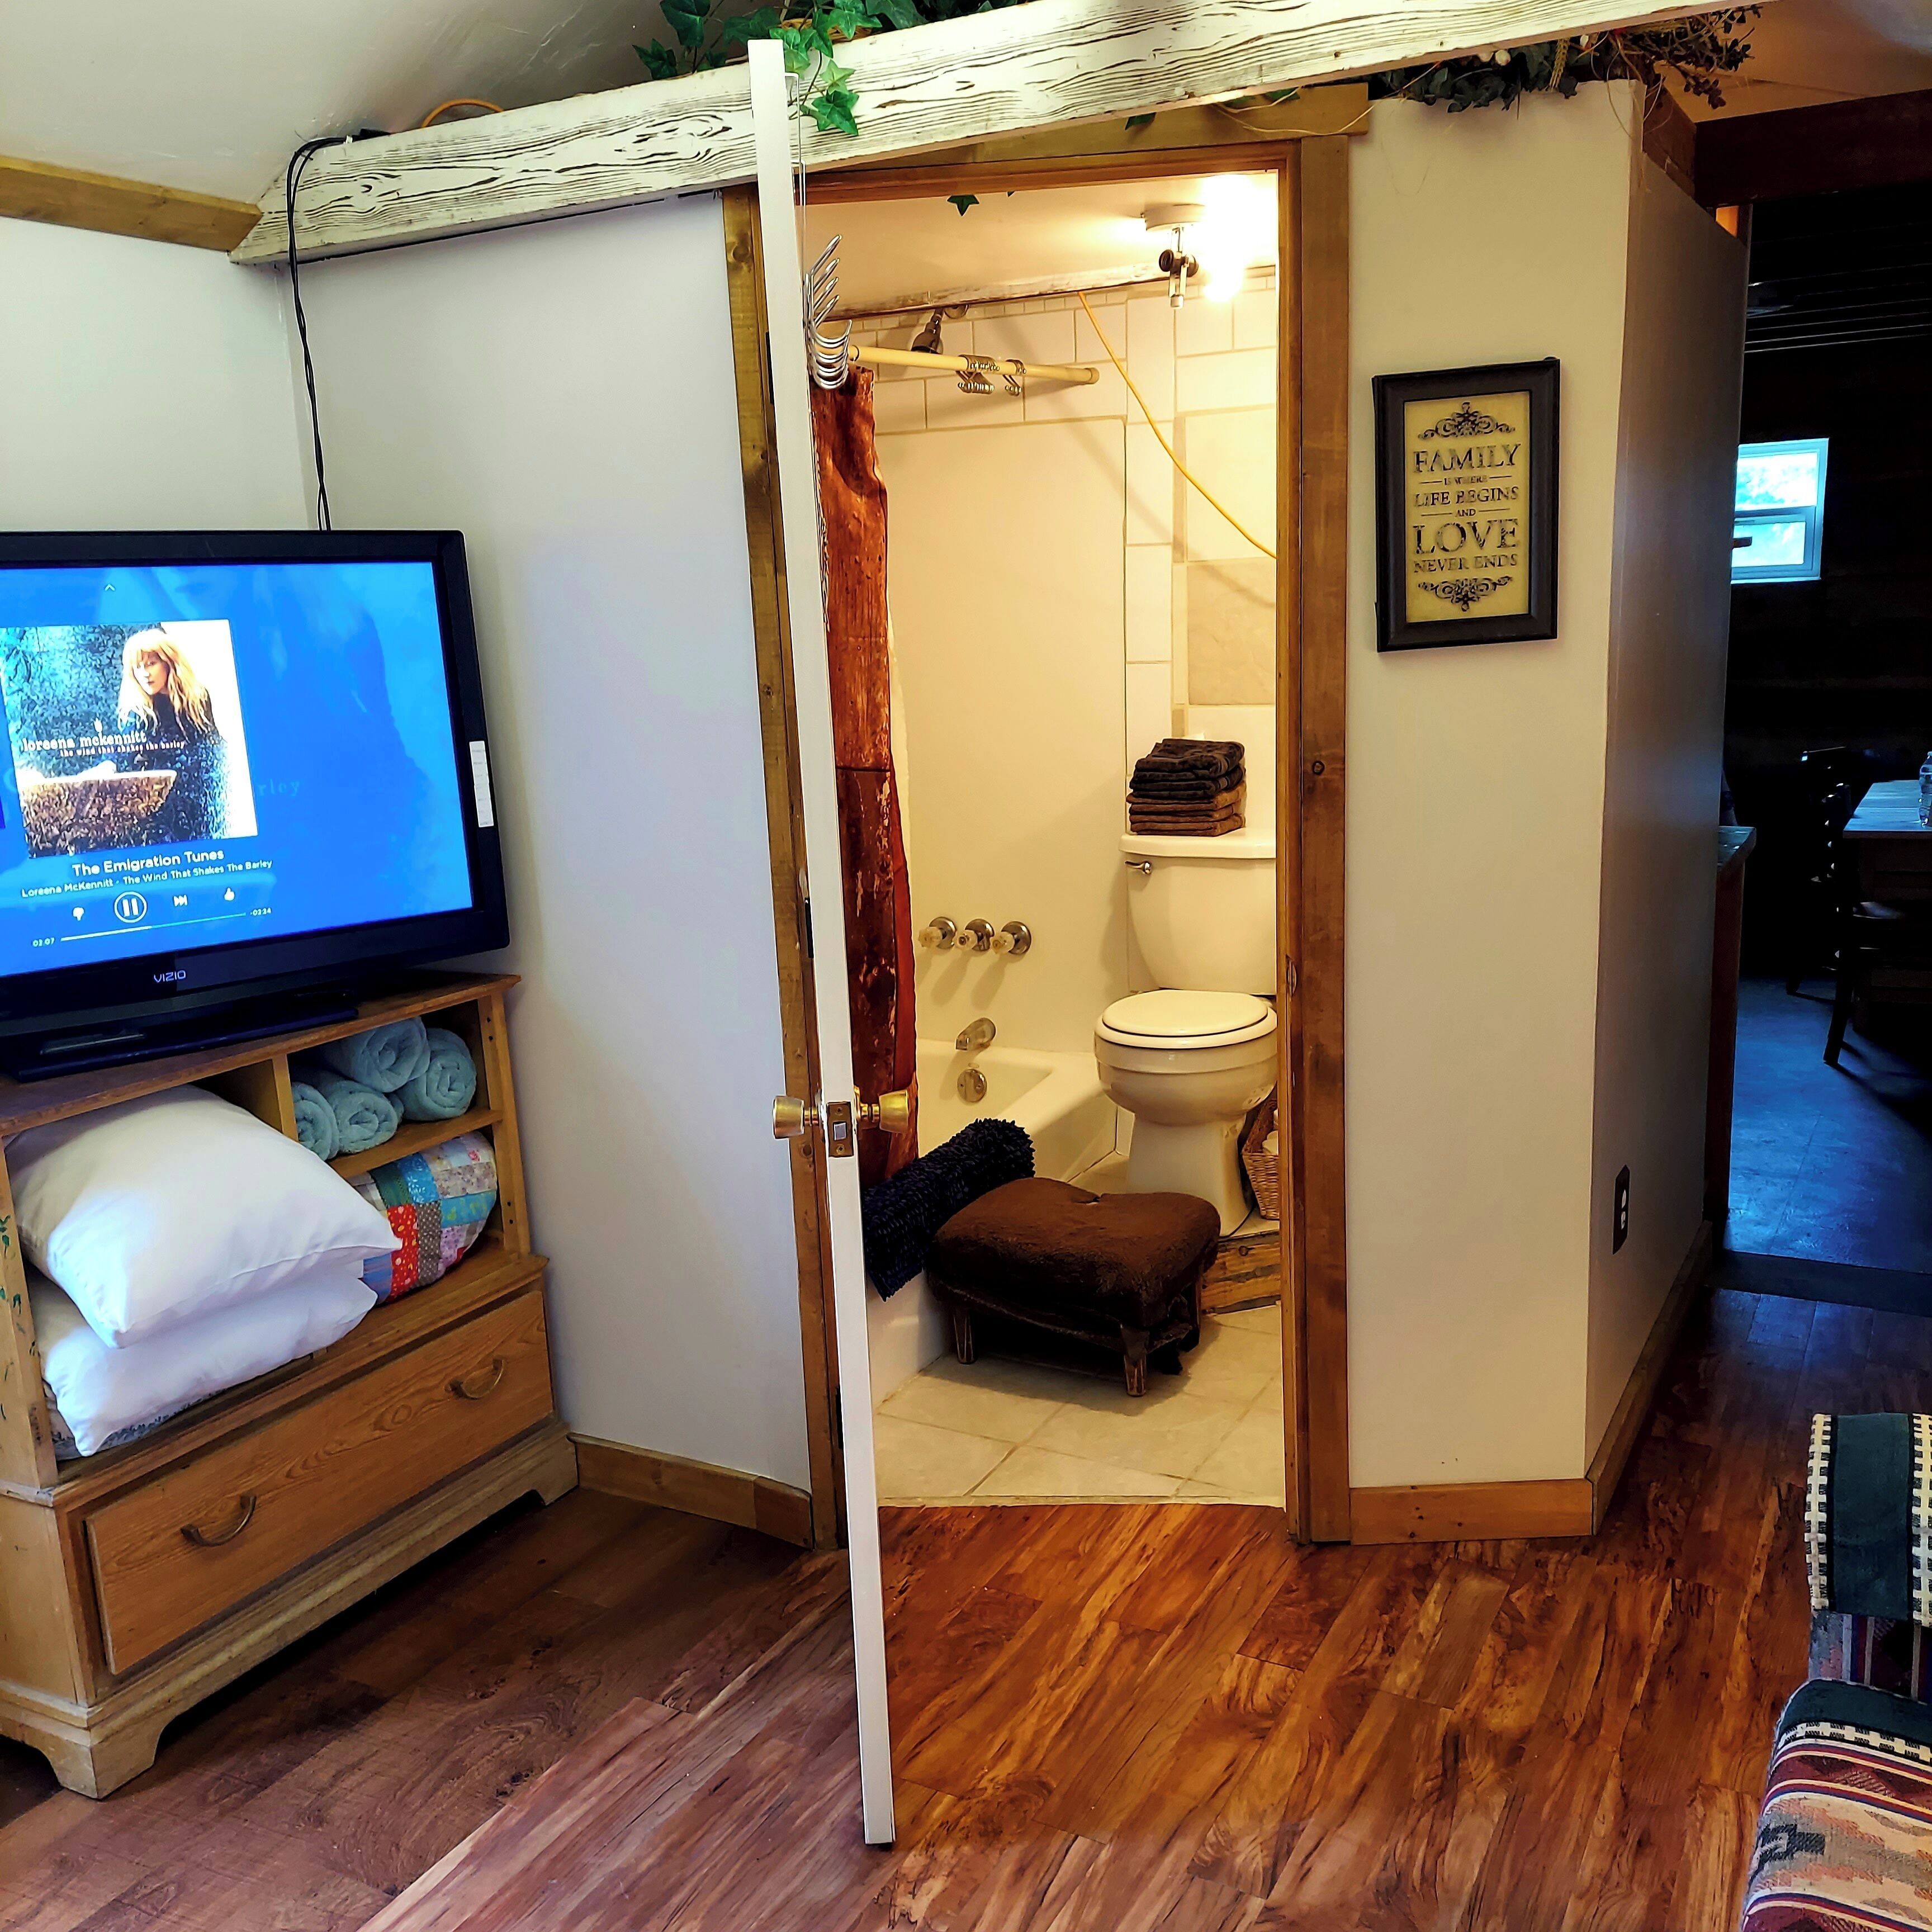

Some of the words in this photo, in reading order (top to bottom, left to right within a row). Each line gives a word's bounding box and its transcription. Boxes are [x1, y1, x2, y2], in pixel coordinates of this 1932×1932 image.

[1413, 443, 1521, 473] FAMILY
[1414, 491, 1451, 506] LIFE
[1455, 486, 1519, 504] BEGINS
[1455, 508, 1476, 518] AND
[1413, 519, 1519, 555] LOVE
[1414, 557, 1469, 574] NEVER
[1474, 553, 1518, 569] ENDS
[22, 738, 75, 752] loreena
[72, 863, 100, 877] The
[103, 854, 181, 873] Emigration
[183, 850, 224, 863] Tunes
[21, 886, 62, 898] Loreena
[64, 878, 113, 893] McKennitt
[122, 875, 141, 885] The
[142, 871, 168, 883] Wind
[170, 869, 191, 879] That
[193, 865, 224, 877] Shakes
[227, 863, 243, 872] The
[245, 860, 272, 870] Barley
[153, 970, 186, 983] VIZIO
